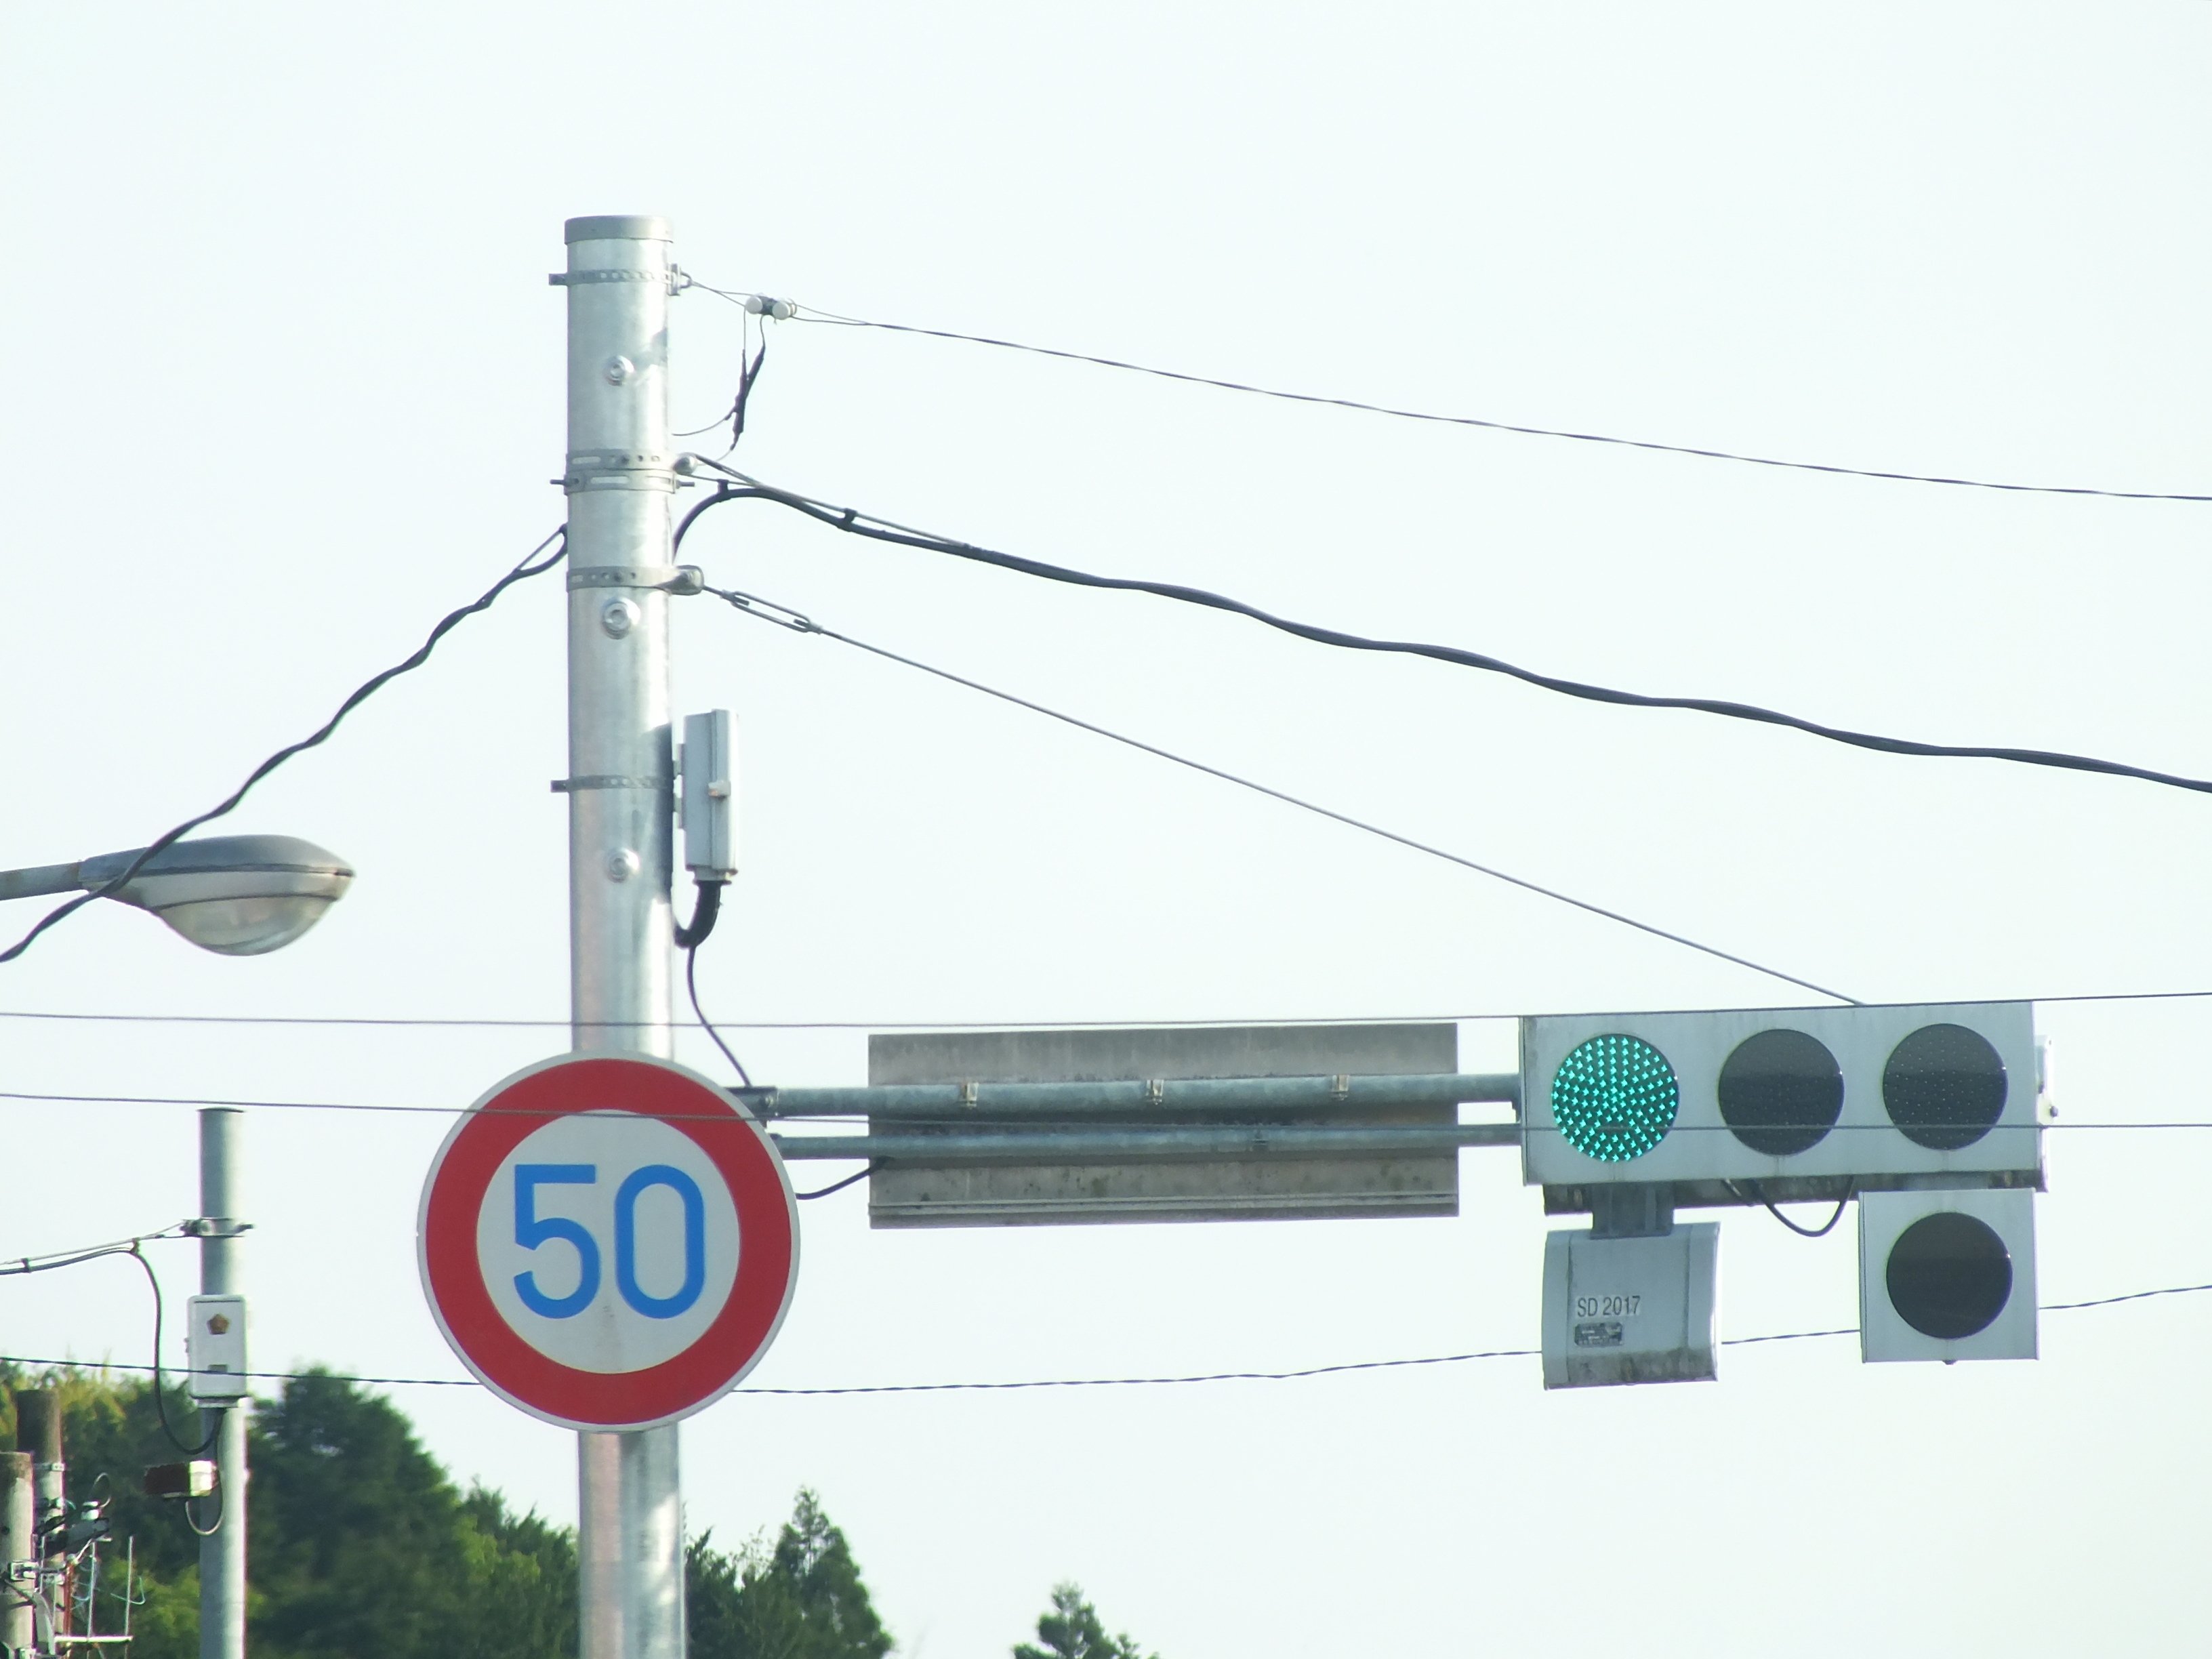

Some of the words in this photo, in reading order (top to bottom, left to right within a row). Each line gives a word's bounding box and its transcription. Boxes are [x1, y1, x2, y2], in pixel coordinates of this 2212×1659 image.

[514, 1164, 705, 1319] 50
[1577, 1297, 1598, 1317] SD
[1602, 1295, 1641, 1316] 2017
